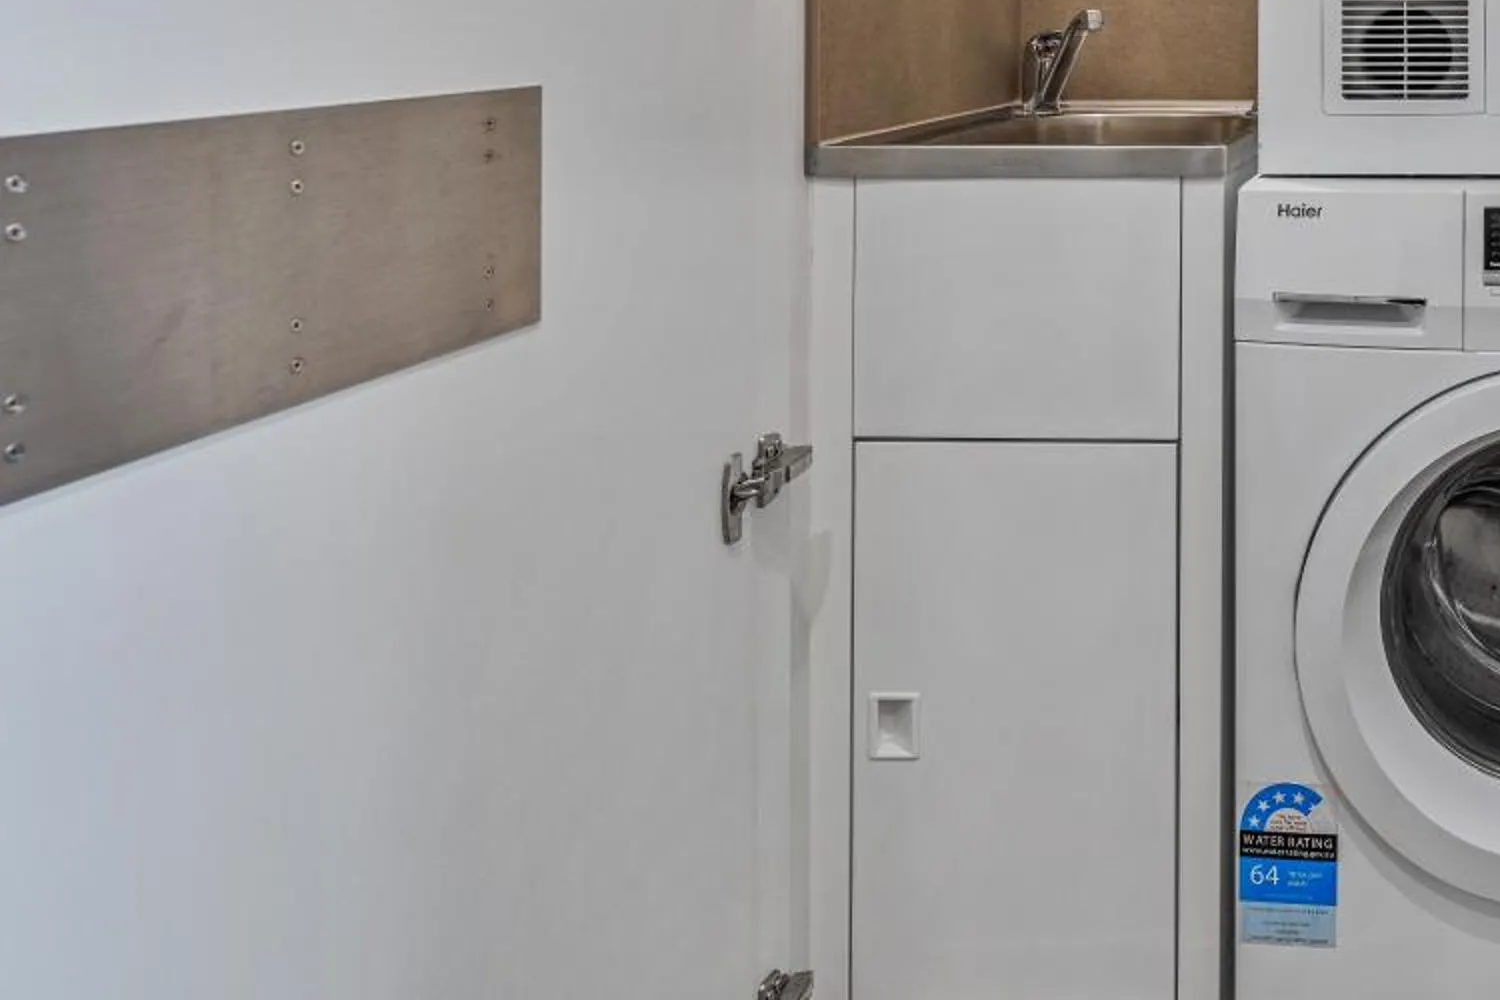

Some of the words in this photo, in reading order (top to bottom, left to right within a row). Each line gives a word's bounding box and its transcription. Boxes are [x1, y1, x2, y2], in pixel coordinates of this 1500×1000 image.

[1276, 203, 1322, 218] Haier
[1243, 833, 1285, 847] WATER
[1287, 836, 1333, 850] RATING
[1250, 863, 1280, 886] 64
